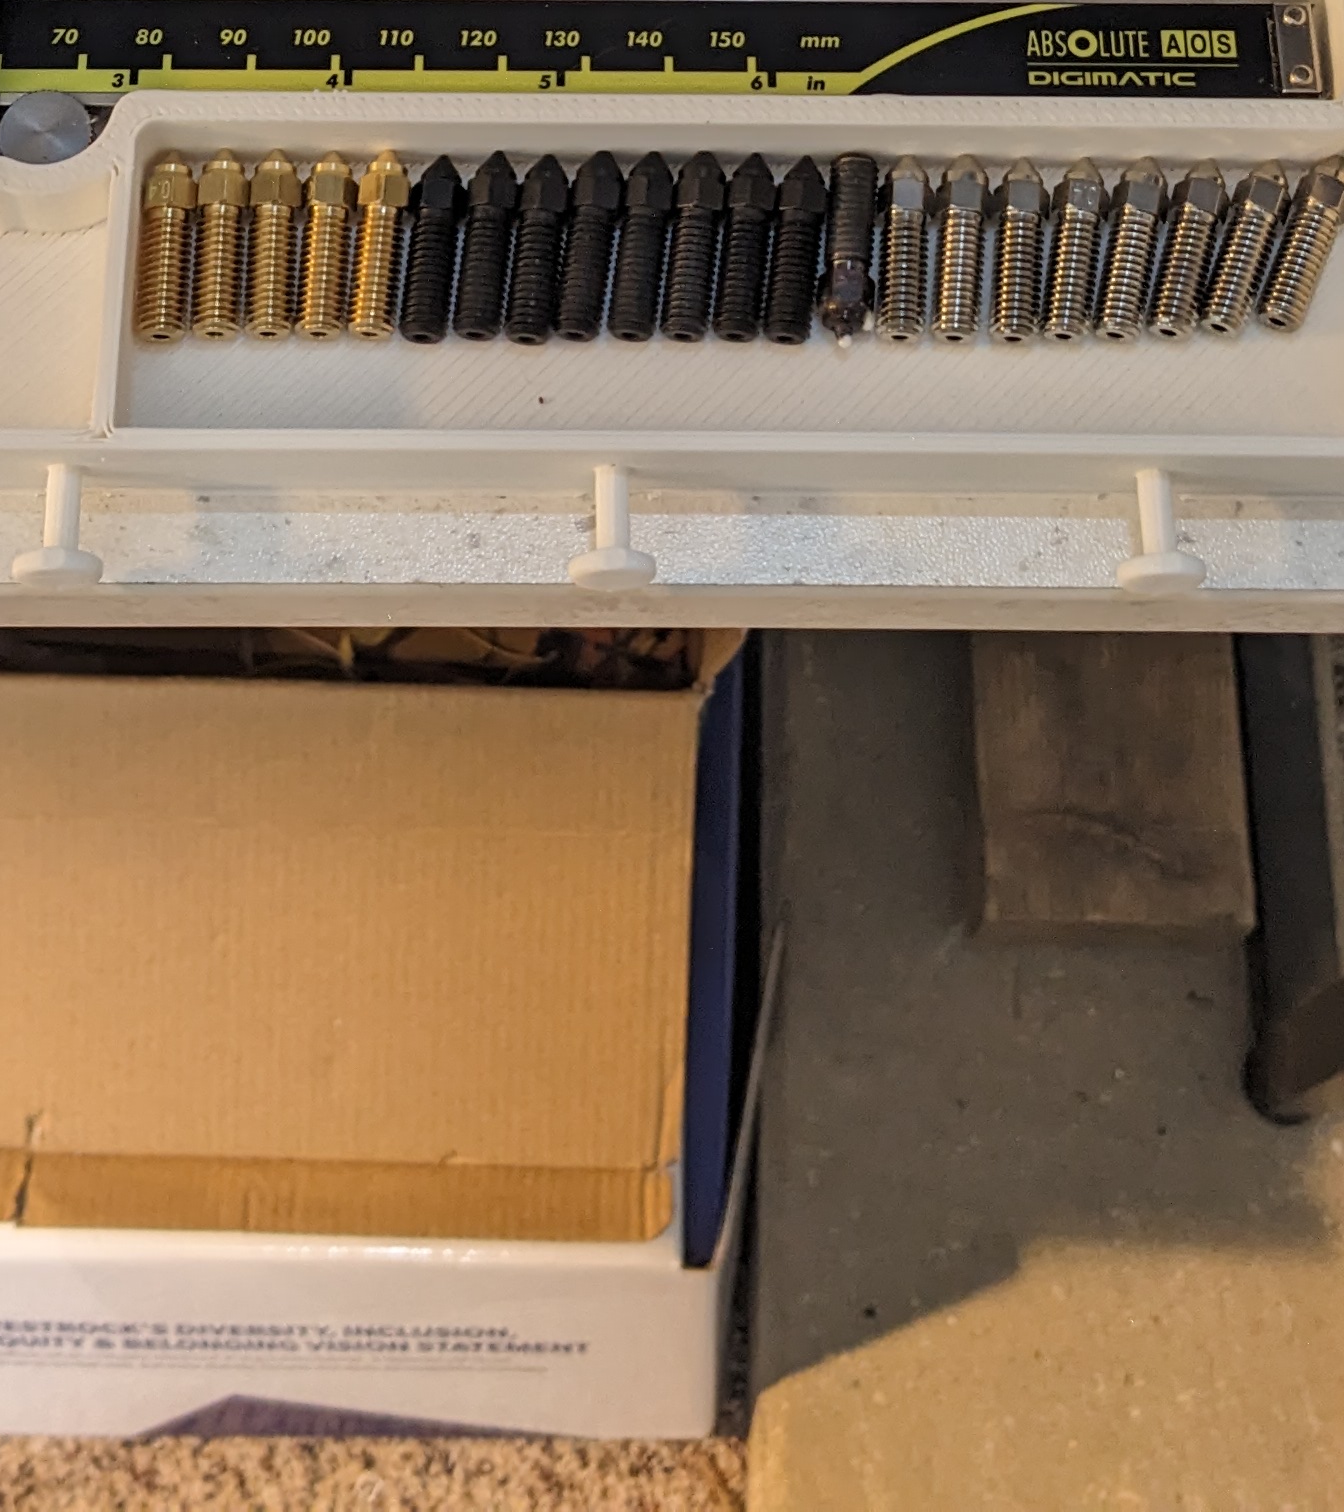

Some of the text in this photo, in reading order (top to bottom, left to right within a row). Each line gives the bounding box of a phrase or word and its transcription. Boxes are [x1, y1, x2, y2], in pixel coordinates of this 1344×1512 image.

[51, 28, 840, 50] 70 80 90 100 110 120 130 140 150 mm
[1027, 28, 1149, 58] ABSOLUTE
[112, 74, 826, 92] 3 4 5 6 in
[1028, 72, 1196, 86] DIGIMATIC
